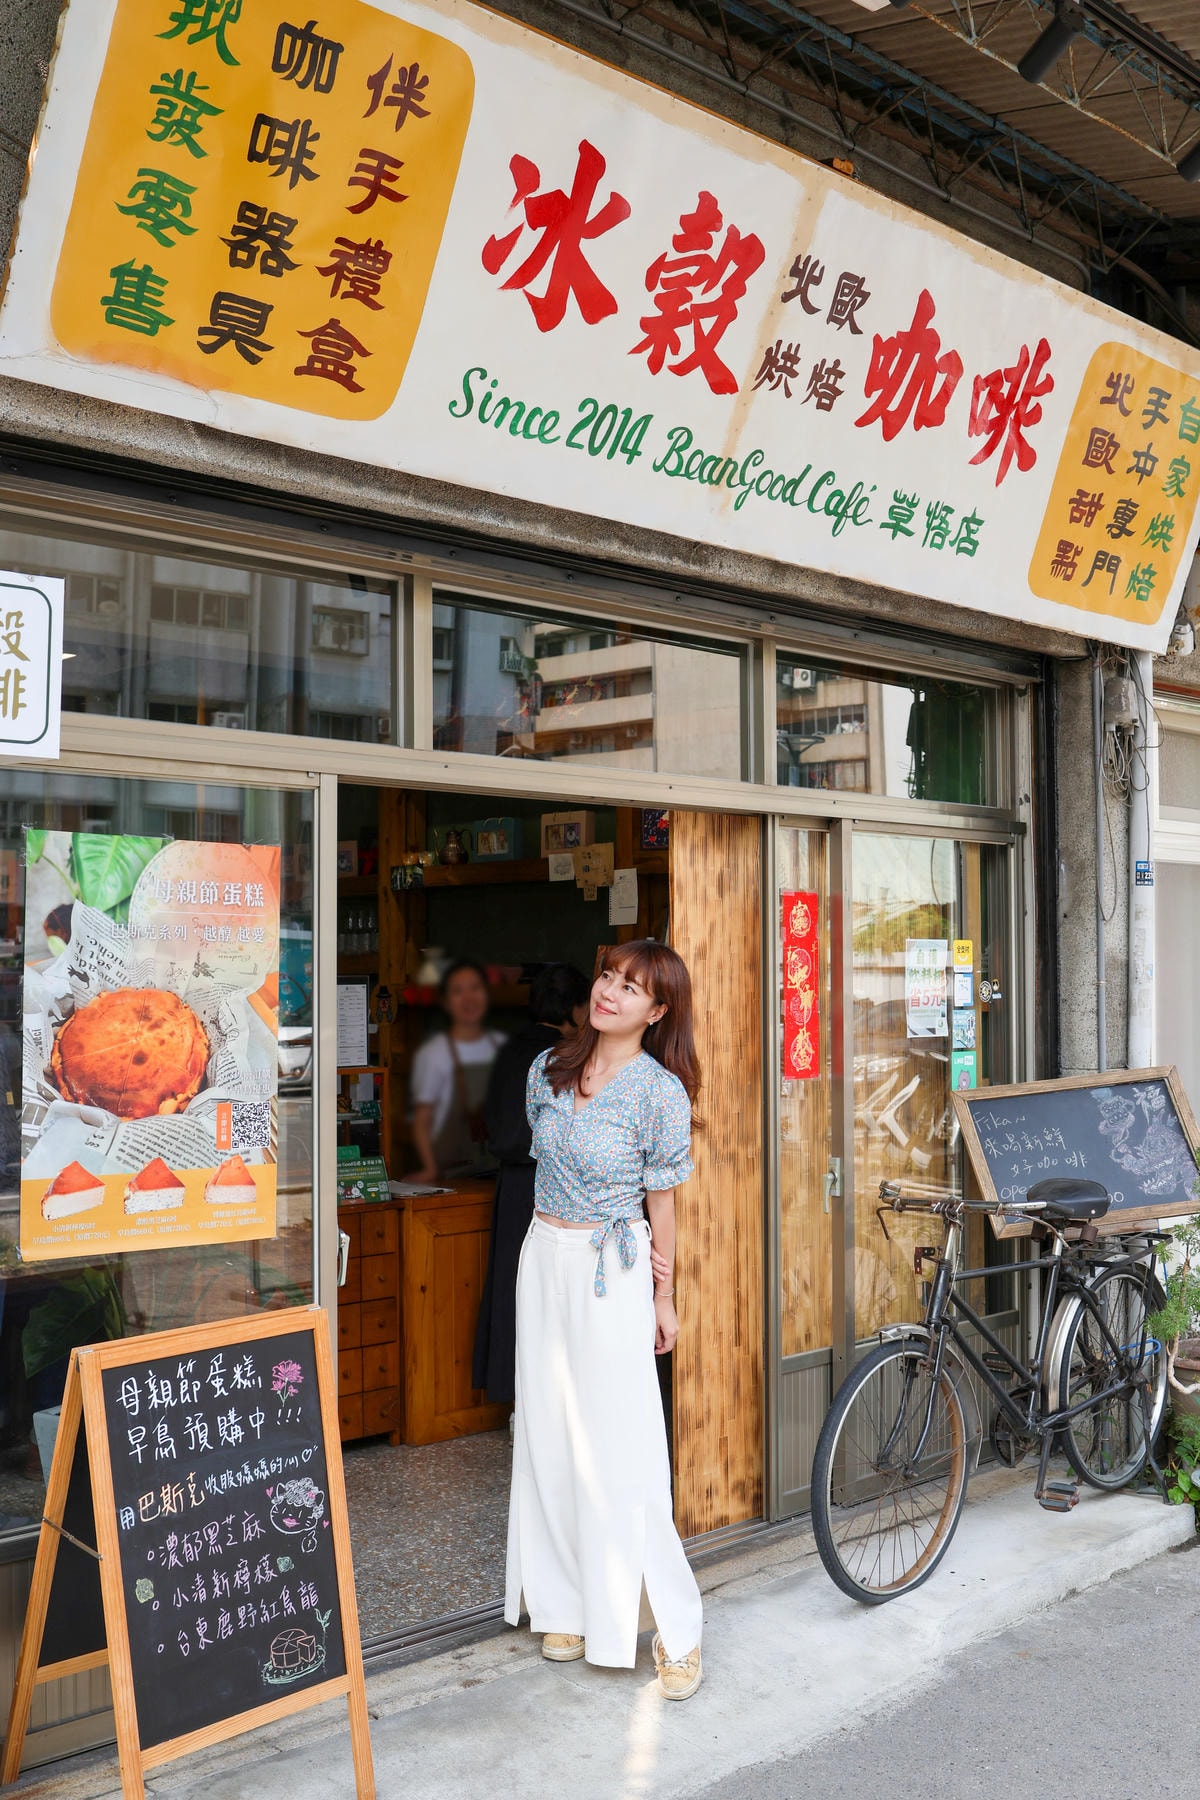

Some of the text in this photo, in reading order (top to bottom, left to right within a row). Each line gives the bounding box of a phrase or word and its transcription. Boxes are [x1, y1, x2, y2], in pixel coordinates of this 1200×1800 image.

[197, 20, 345, 366] 咖啡器具
[294, 53, 431, 393] 伴手禮盒
[781, 254, 871, 335] 北歐
[750, 339, 845, 413] 烘焙
[854, 289, 1055, 487] 咖啡
[449, 366, 560, 445] Since
[566, 397, 654, 466] 2014
[879, 487, 985, 558] 草悟店
[1050, 370, 1135, 582] 北歐甜點
[1125, 395, 1200, 603] 自家烘焙
[155, 879, 264, 907] 母親節蛋糕
[910, 988, 942, 1009] 省5元
[984, 1127, 1068, 1159] 來喝新鮮
[116, 1353, 262, 1416] 母親節蛋糕
[172, 1554, 280, 1609] 小清新檸檬
